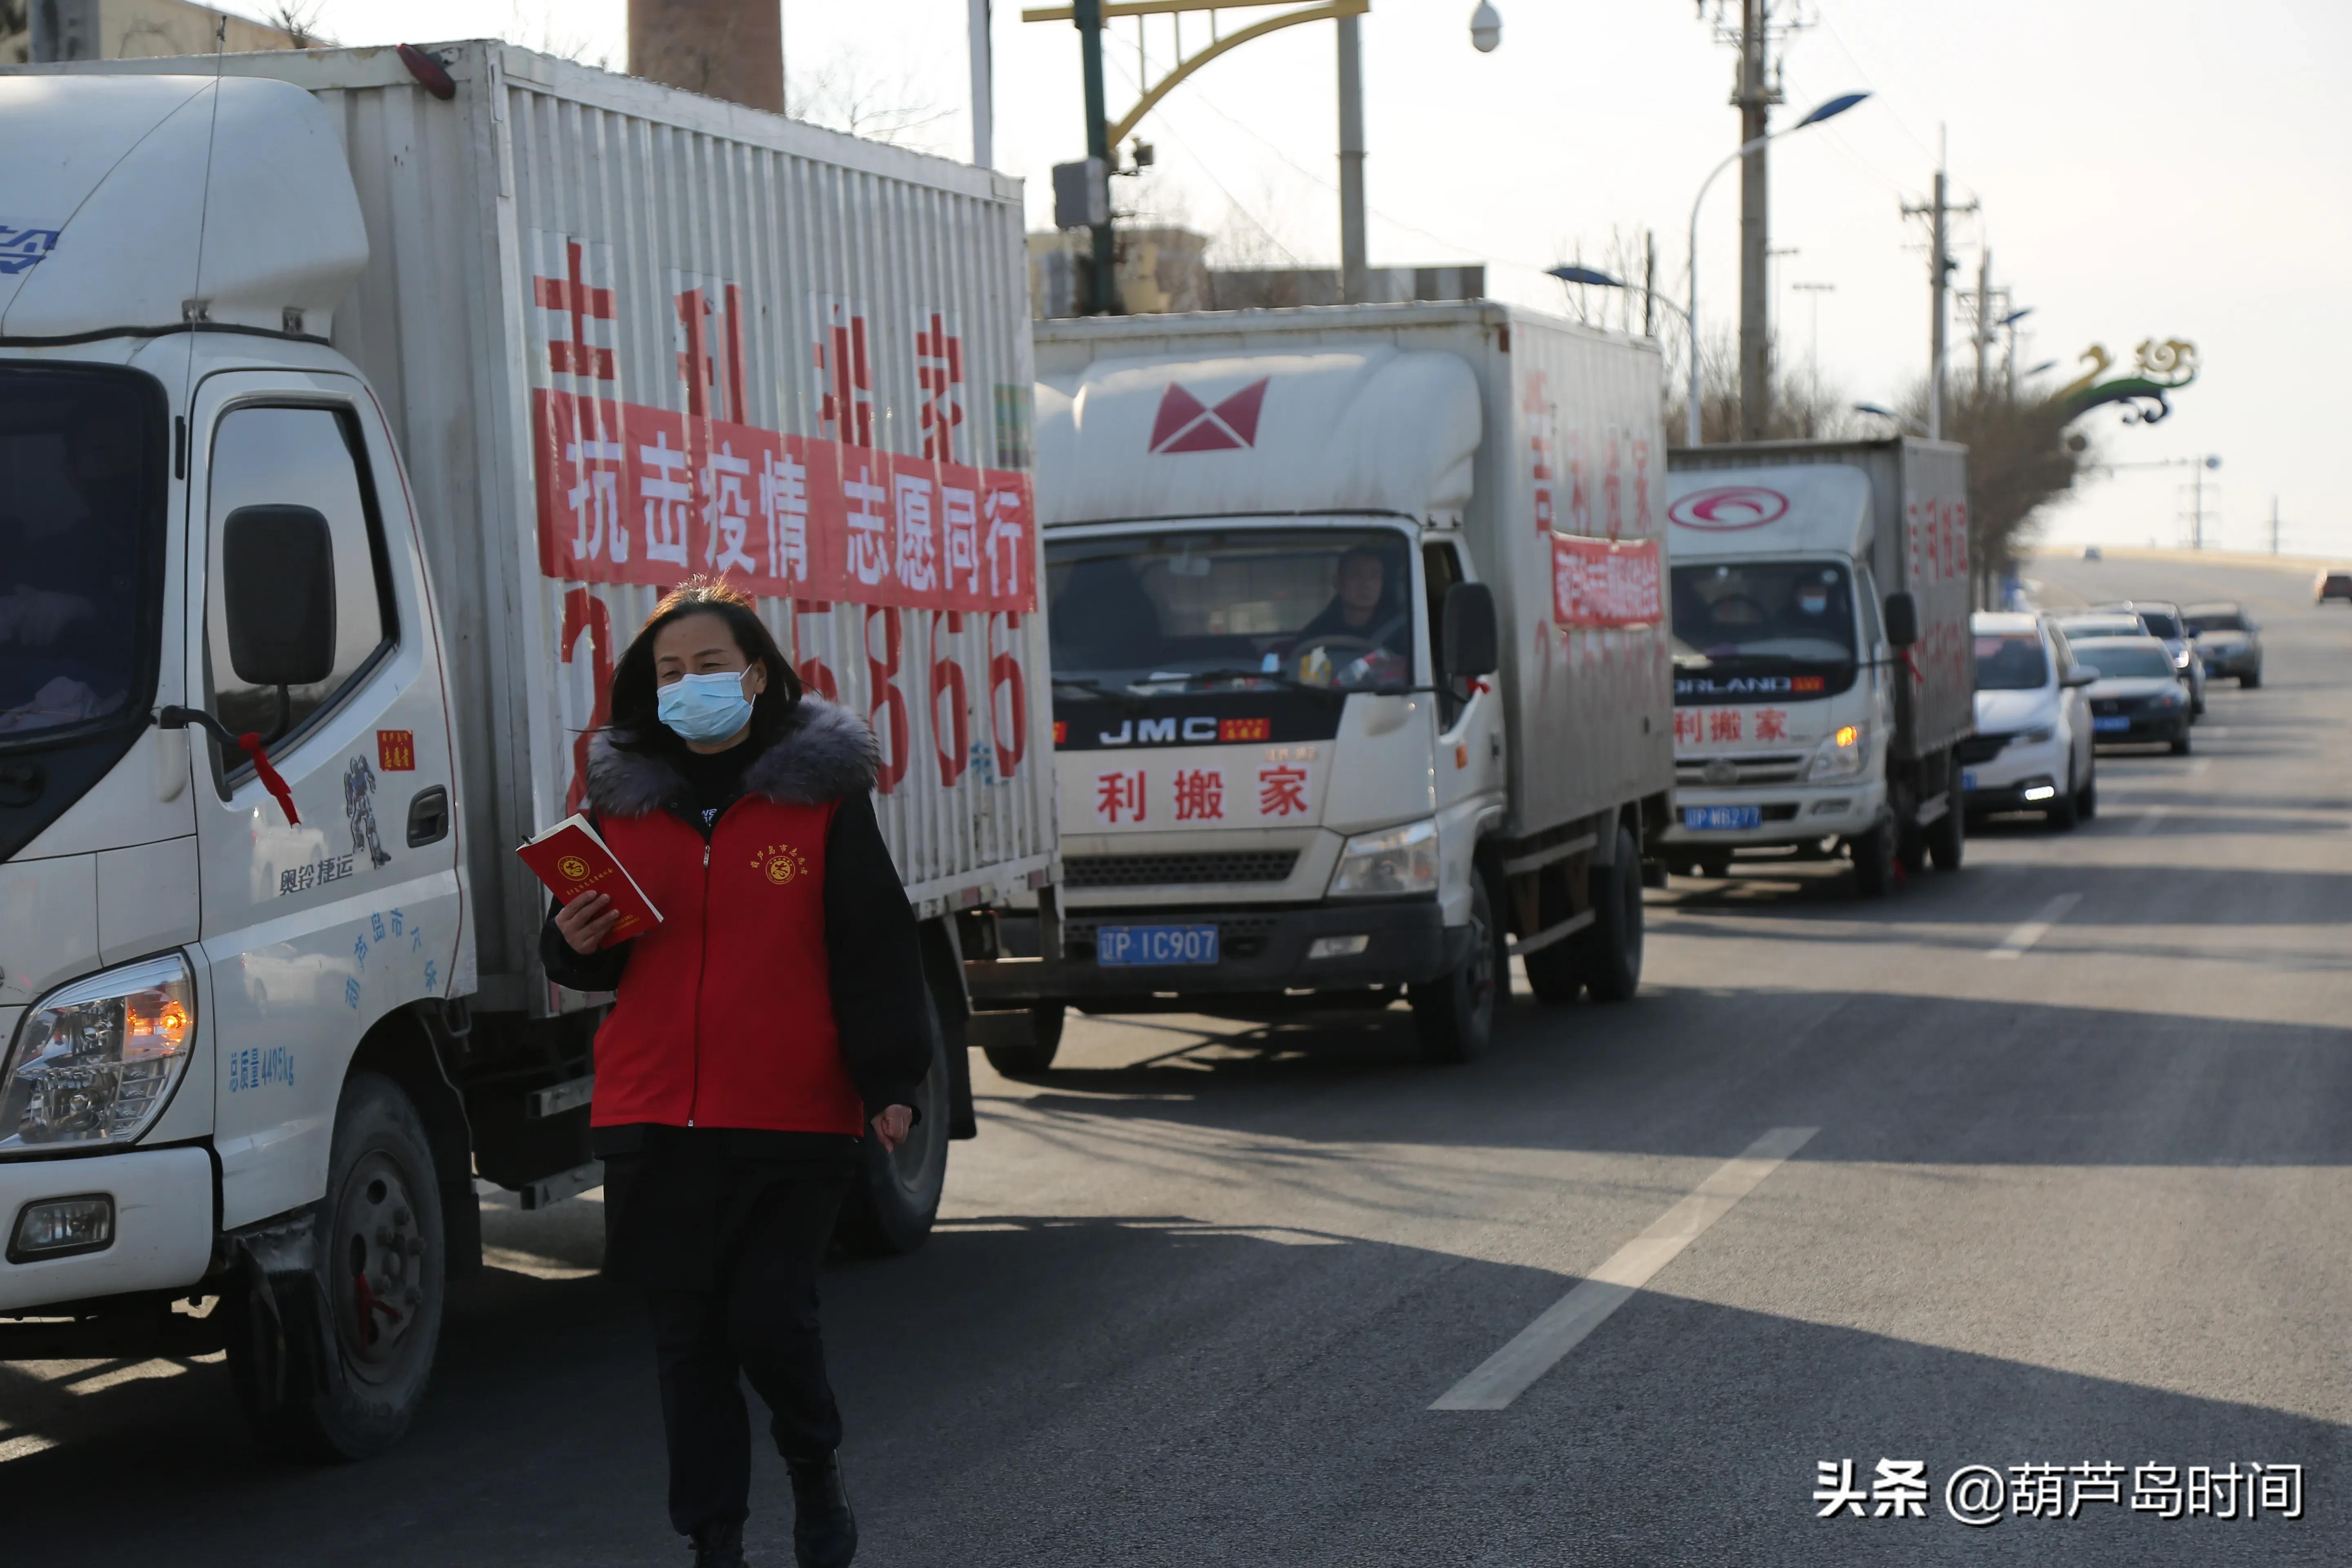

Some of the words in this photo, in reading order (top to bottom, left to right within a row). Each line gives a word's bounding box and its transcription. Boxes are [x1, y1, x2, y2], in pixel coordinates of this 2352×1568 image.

[565, 421, 808, 581] 抗击疫情
[843, 466, 1022, 598] 志愿同行
[1099, 717, 1217, 744] JMC
[1097, 765, 1309, 822] 利搬家
[279, 854, 353, 896] 奥铃捷运
[229, 1046, 294, 1093] 总质量4495kg
